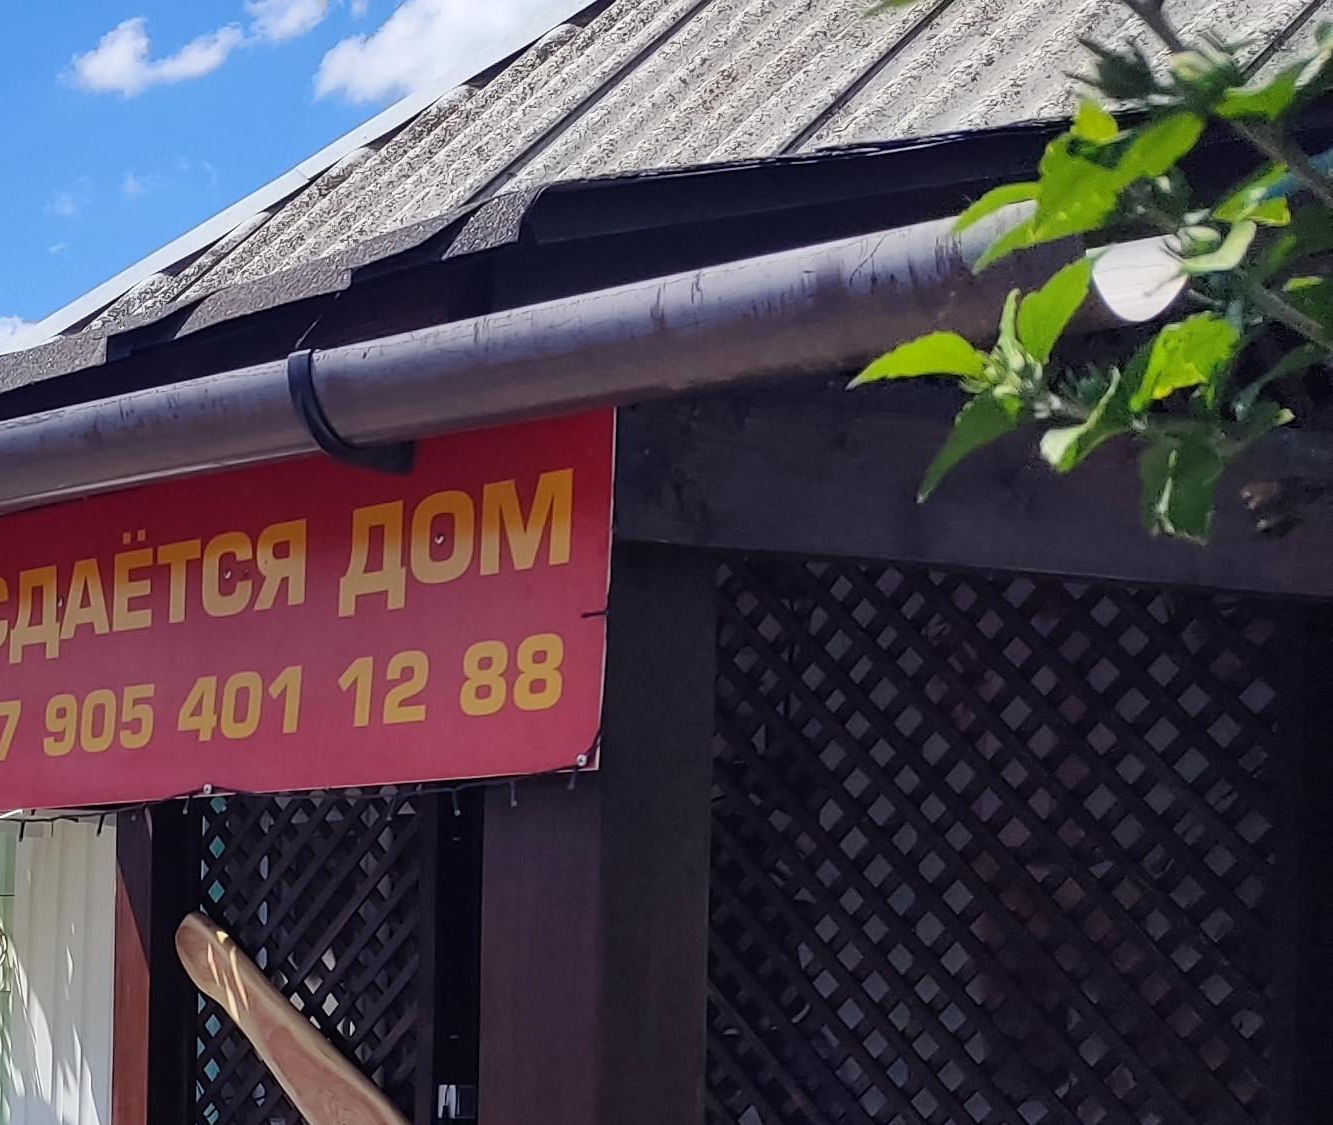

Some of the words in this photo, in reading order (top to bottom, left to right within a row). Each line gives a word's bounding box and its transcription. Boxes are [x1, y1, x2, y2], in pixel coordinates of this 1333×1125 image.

[338, 467, 574, 618] ДОМ
[42, 684, 156, 757] 905
[177, 665, 303, 742] 401
[338, 650, 430, 728] 12
[459, 633, 565, 717] 88
